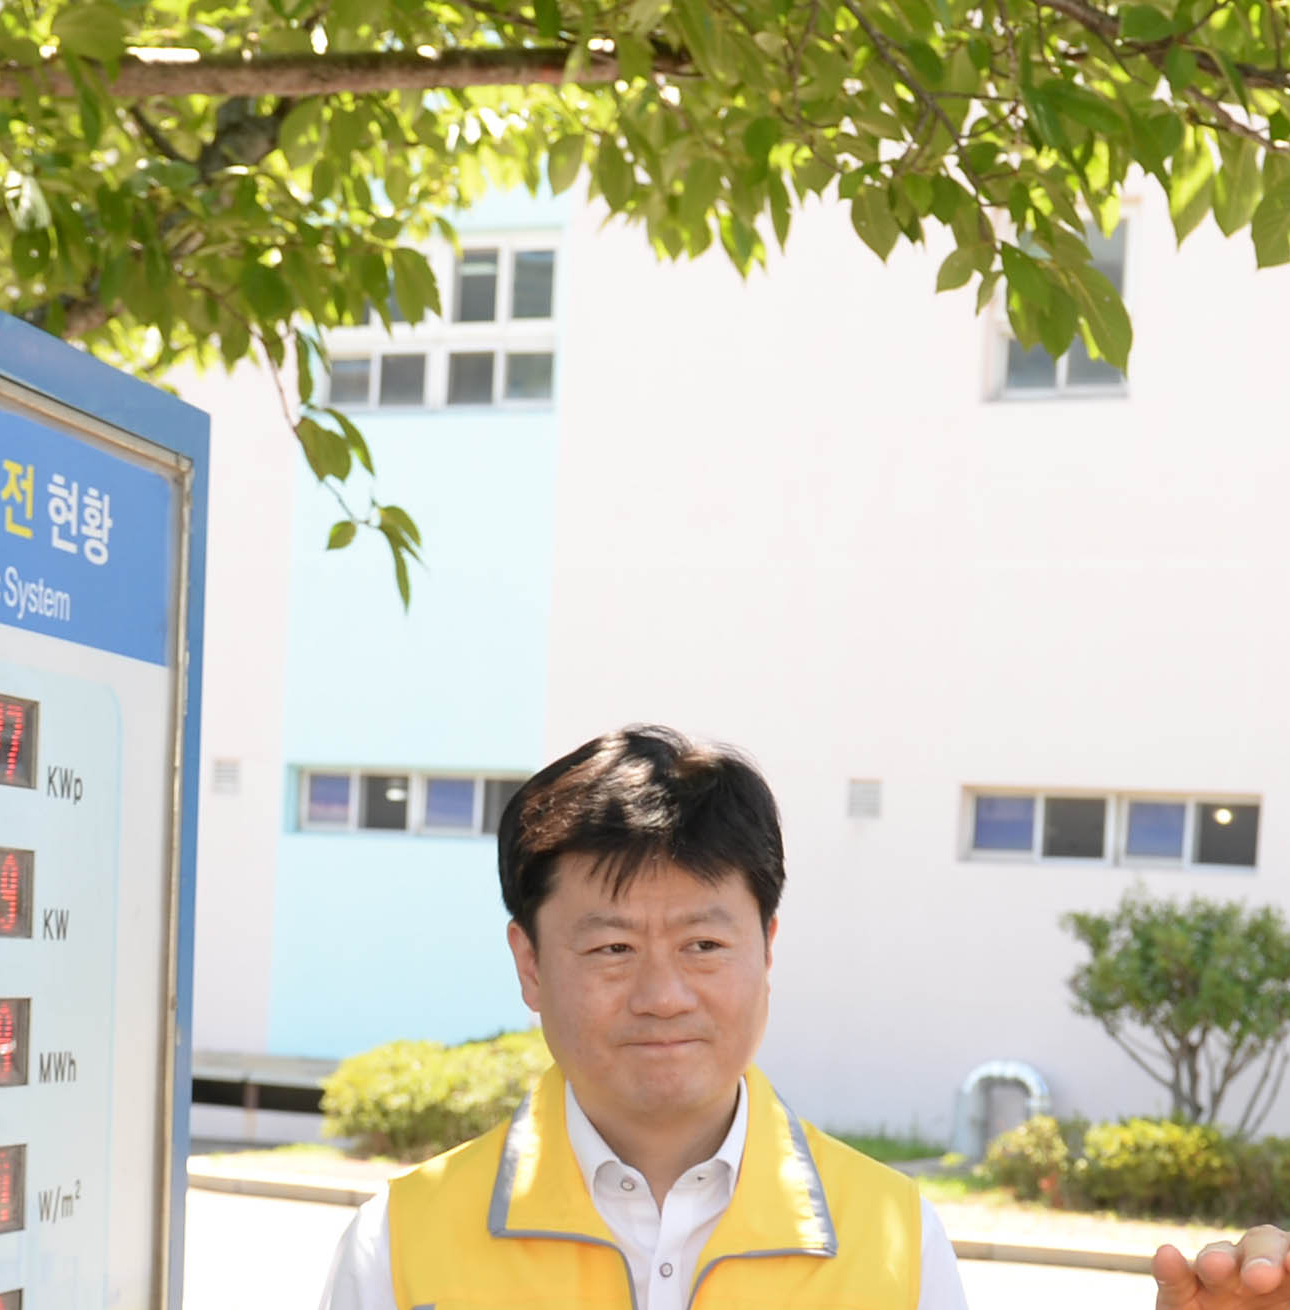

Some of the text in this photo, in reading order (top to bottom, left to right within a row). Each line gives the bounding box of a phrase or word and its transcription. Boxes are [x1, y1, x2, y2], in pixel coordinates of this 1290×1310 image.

[47, 472, 112, 566] 현황
[3, 564, 70, 622] System
[47, 765, 84, 805] KWp
[42, 908, 70, 941] KW
[38, 1050, 77, 1084] MWh
